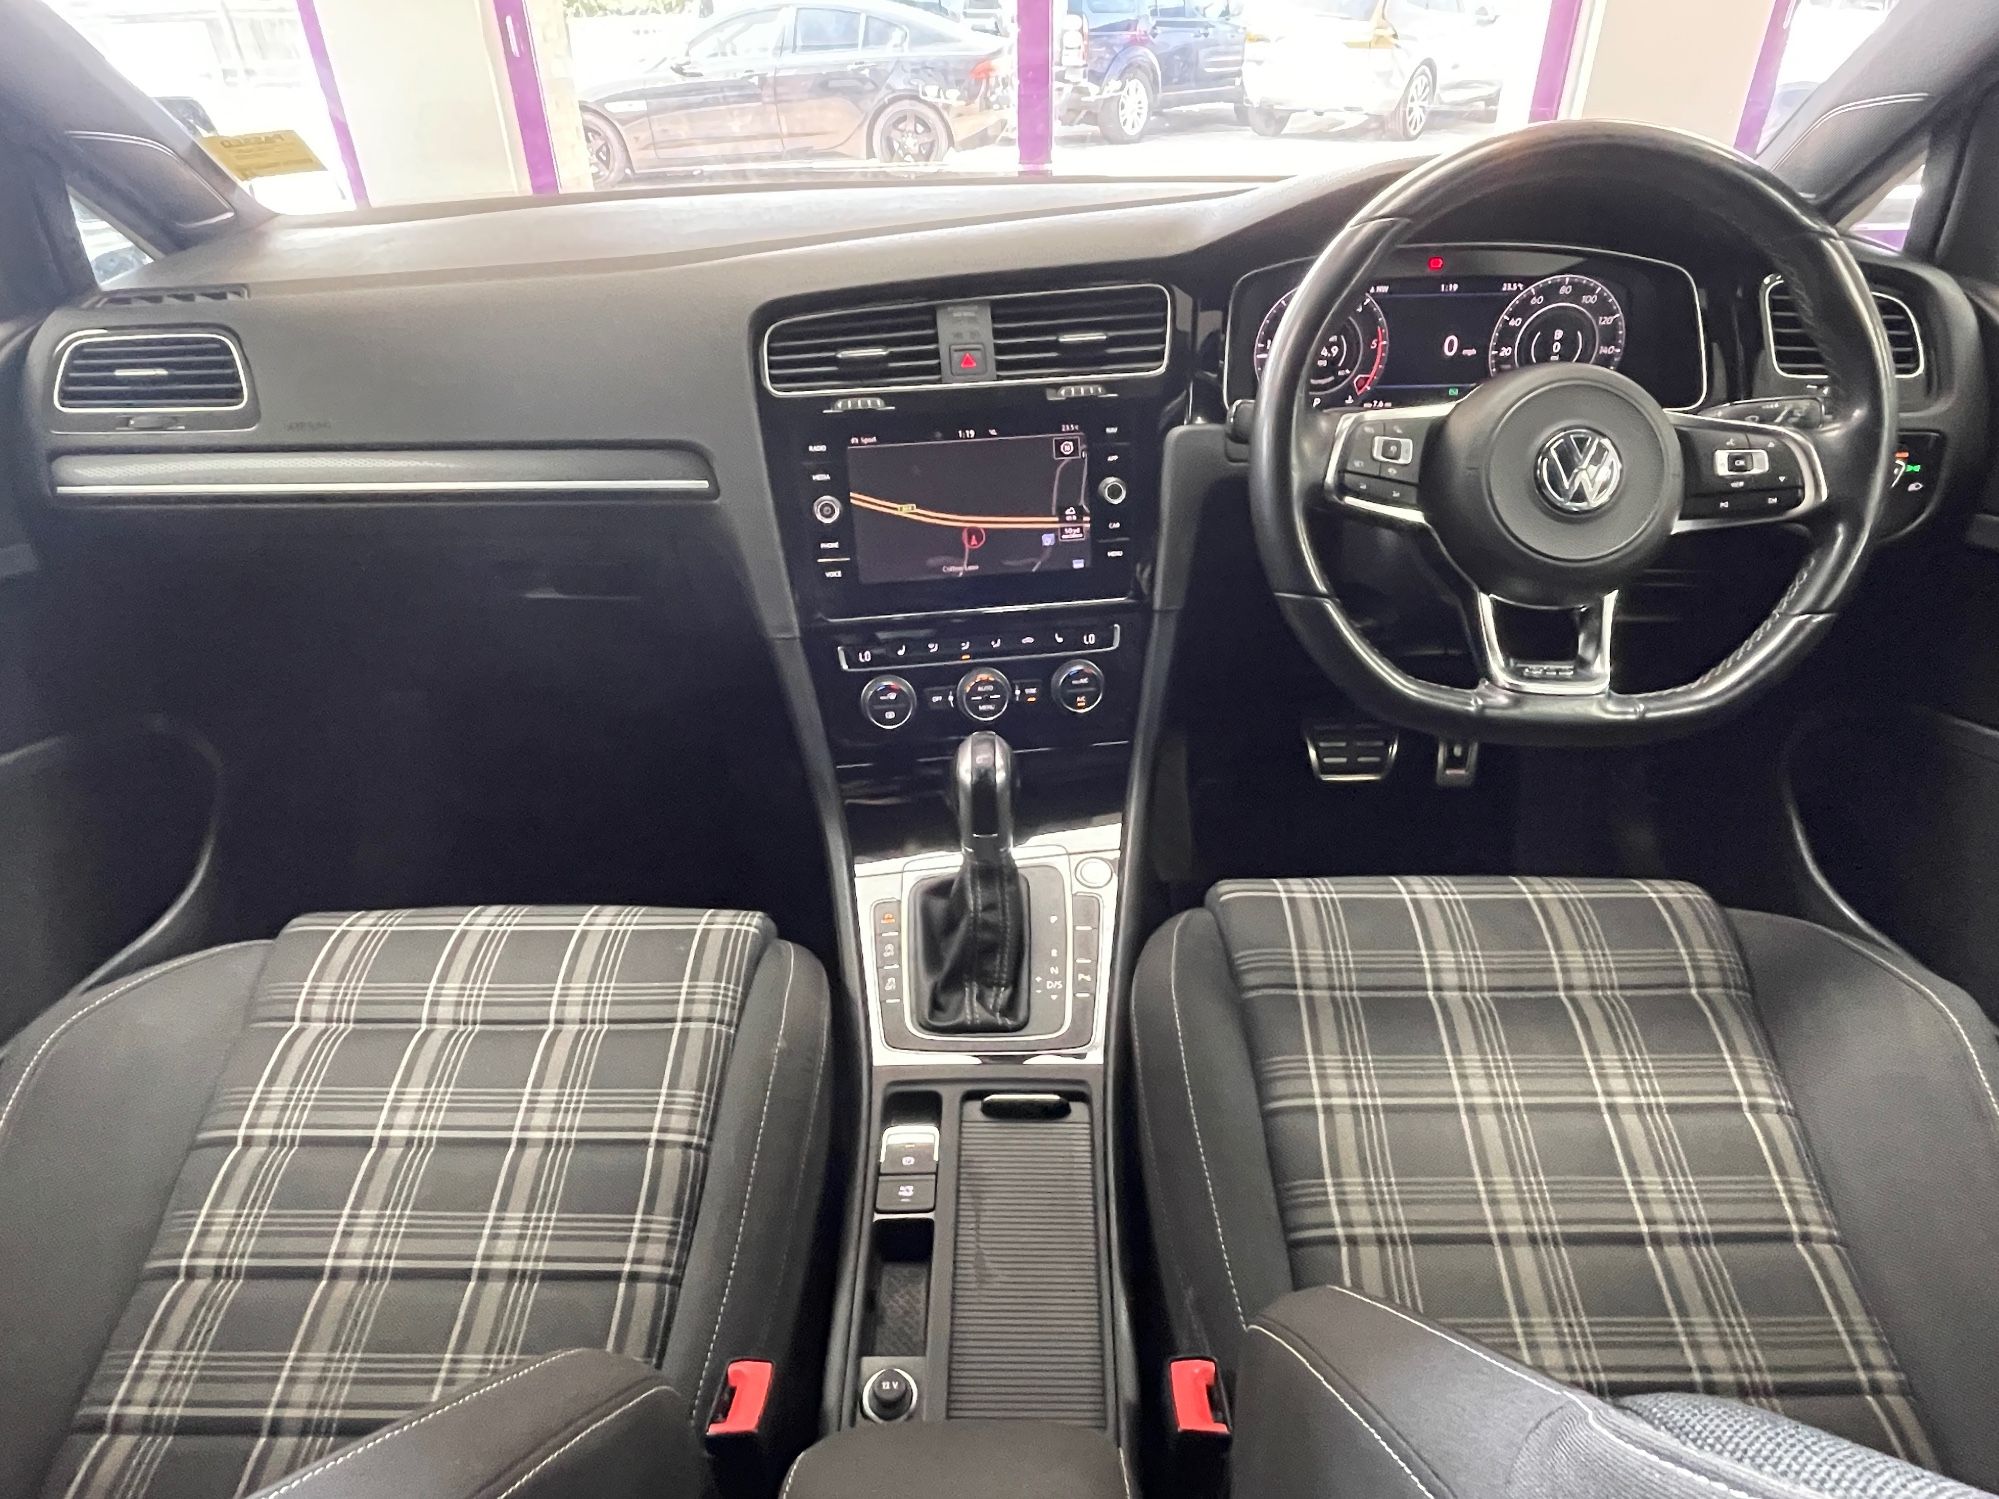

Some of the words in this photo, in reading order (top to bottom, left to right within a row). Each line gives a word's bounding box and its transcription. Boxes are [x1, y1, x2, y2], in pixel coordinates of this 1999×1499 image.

[1560, 285, 1572, 294] 80
[1530, 296, 1544, 304] 60
[1581, 295, 1598, 304] 100
[1509, 318, 1522, 326] 40
[1599, 316, 1614, 325] 120
[1443, 335, 1458, 356] 0
[1552, 342, 1560, 353] 0
[1499, 347, 1512, 356] 20
[1599, 346, 1614, 354] 140
[958, 429, 975, 439] 1:19
[825, 570, 842, 578] VOICE
[1050, 966, 1059, 974] N
[1046, 981, 1063, 989] D/S
[892, 1381, 899, 1389] V
